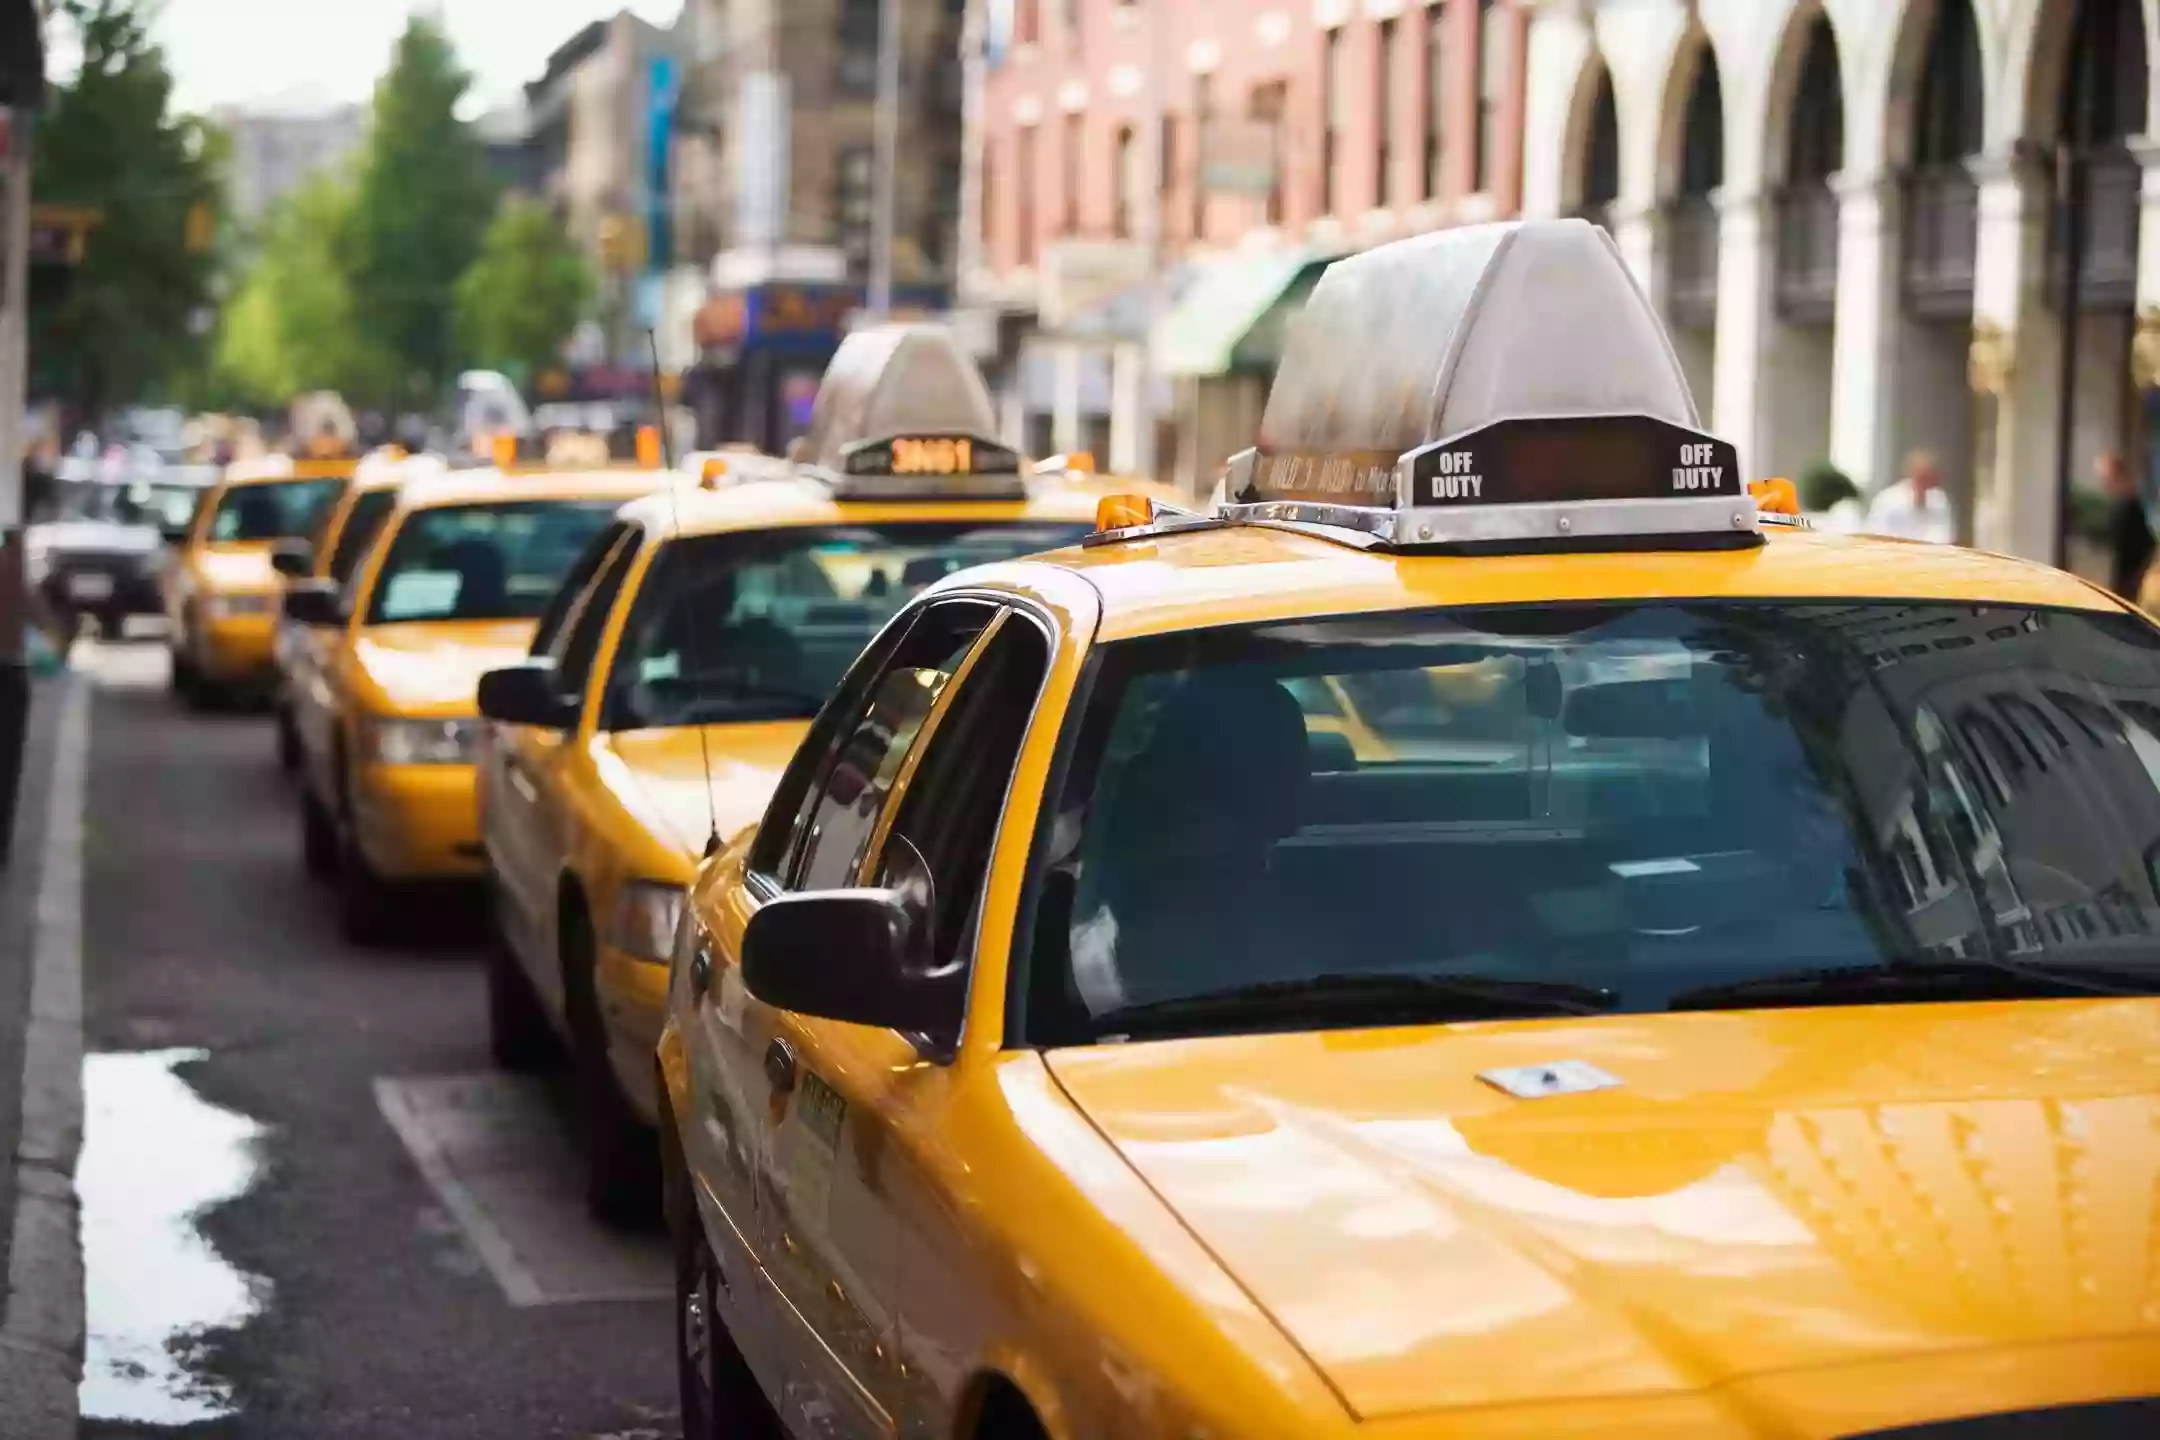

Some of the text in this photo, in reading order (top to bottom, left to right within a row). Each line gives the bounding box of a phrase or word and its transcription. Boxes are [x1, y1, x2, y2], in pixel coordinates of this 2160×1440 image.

[1439, 451, 1473, 474] OFF
[1680, 443, 1713, 466] OFF
[1431, 475, 1483, 498] DUTY
[1672, 466, 1723, 490] DUTY
